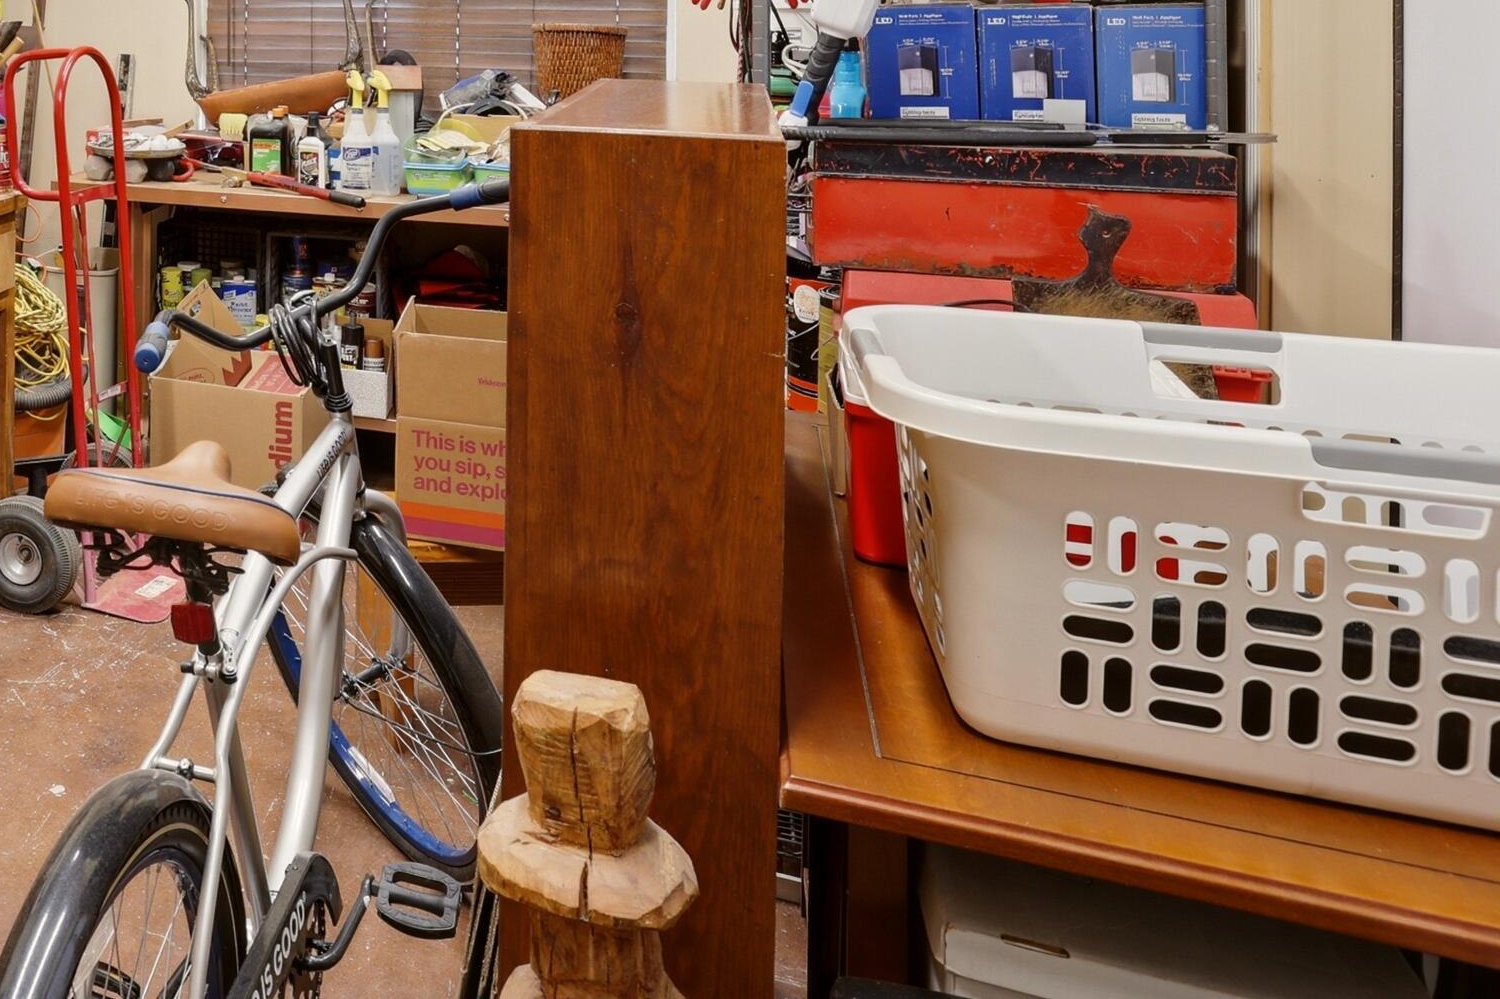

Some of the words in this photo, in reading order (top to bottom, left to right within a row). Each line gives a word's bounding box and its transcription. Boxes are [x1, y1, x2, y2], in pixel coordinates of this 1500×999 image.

[1107, 17, 1126, 26] LED
[412, 430, 455, 451] This
[459, 435, 477, 454] is
[413, 456, 451, 472] you
[455, 458, 491, 480] sip,
[413, 475, 452, 494] and
[152, 499, 230, 532] GOOD
